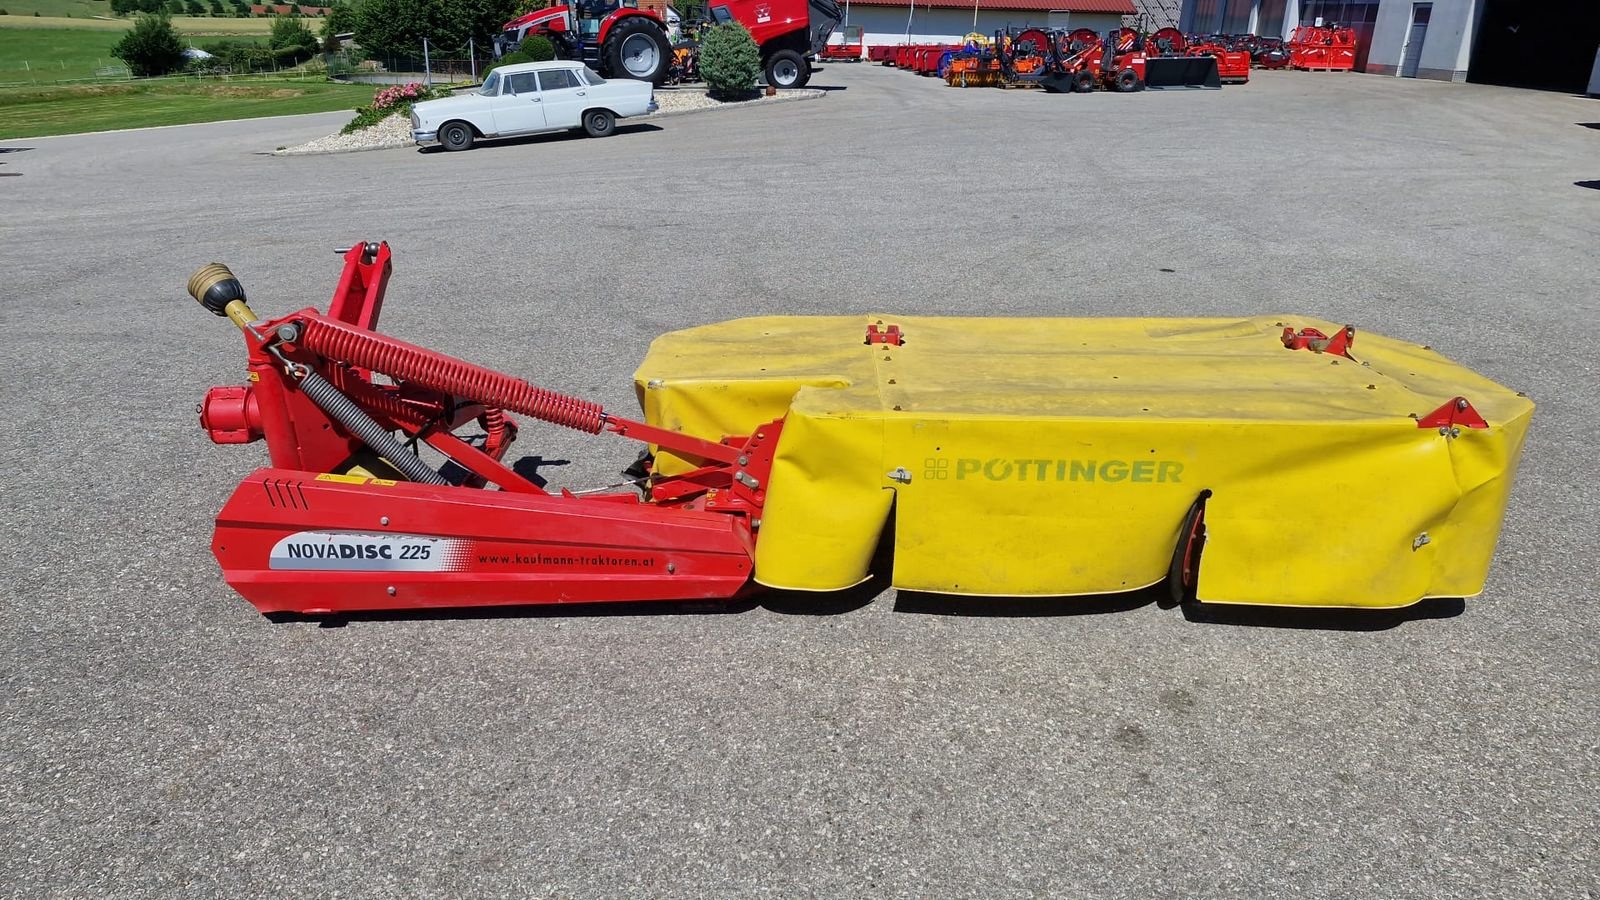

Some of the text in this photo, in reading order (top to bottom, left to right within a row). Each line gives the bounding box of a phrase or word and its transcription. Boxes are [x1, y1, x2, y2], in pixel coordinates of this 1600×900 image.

[287, 543, 431, 560] NOVADISC 225
[478, 553, 655, 567] www.kaufmann-traktoren.at
